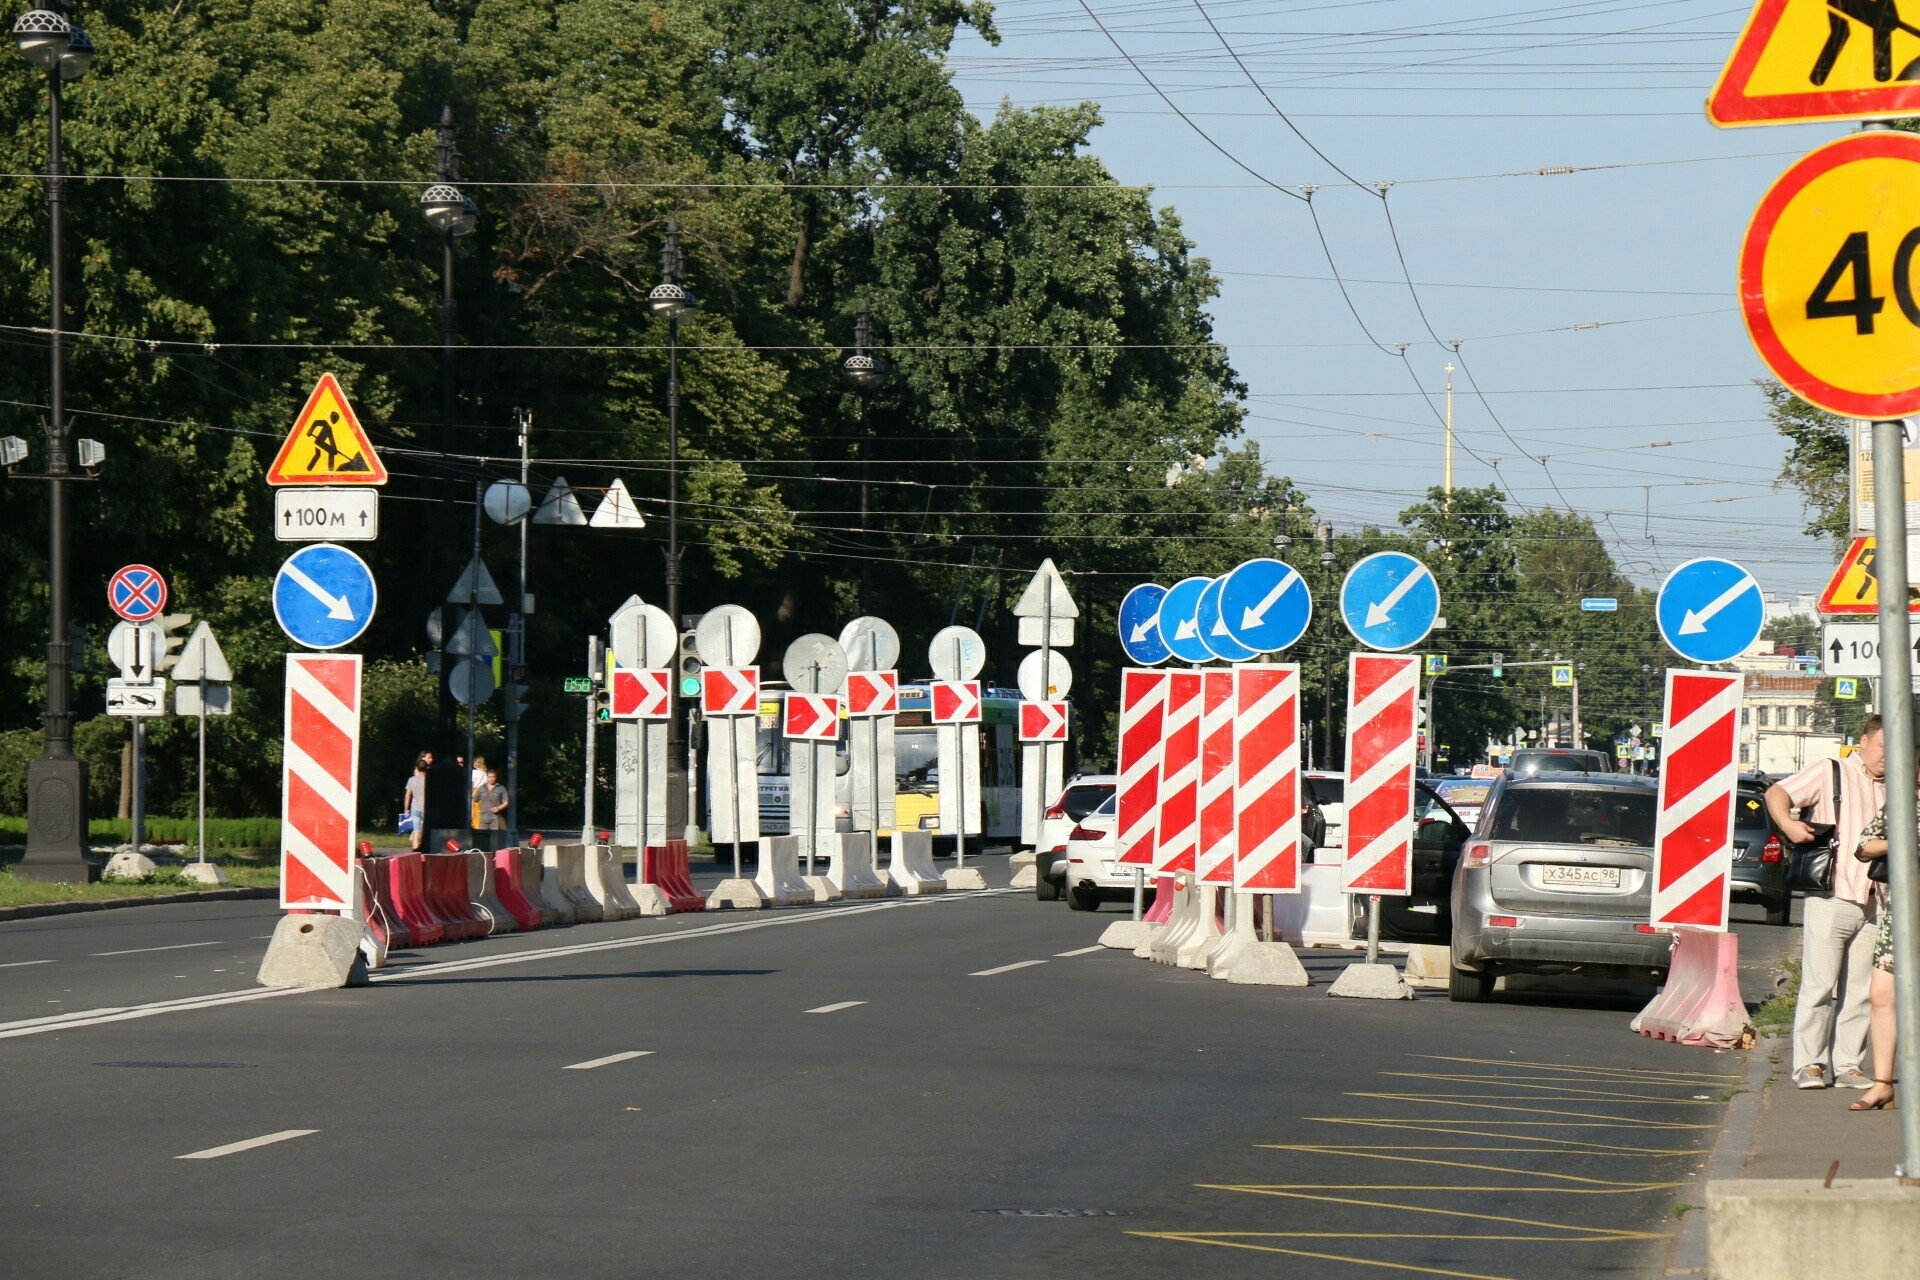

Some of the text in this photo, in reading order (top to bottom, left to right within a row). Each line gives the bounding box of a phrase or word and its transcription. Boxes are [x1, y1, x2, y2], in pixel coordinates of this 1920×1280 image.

[1861, 453, 1873, 461] 12
[296, 508, 327, 526] 100
[1850, 640, 1881, 659] 10
[564, 678, 590, 692] 0:58
[1602, 869, 1615, 879] 98
